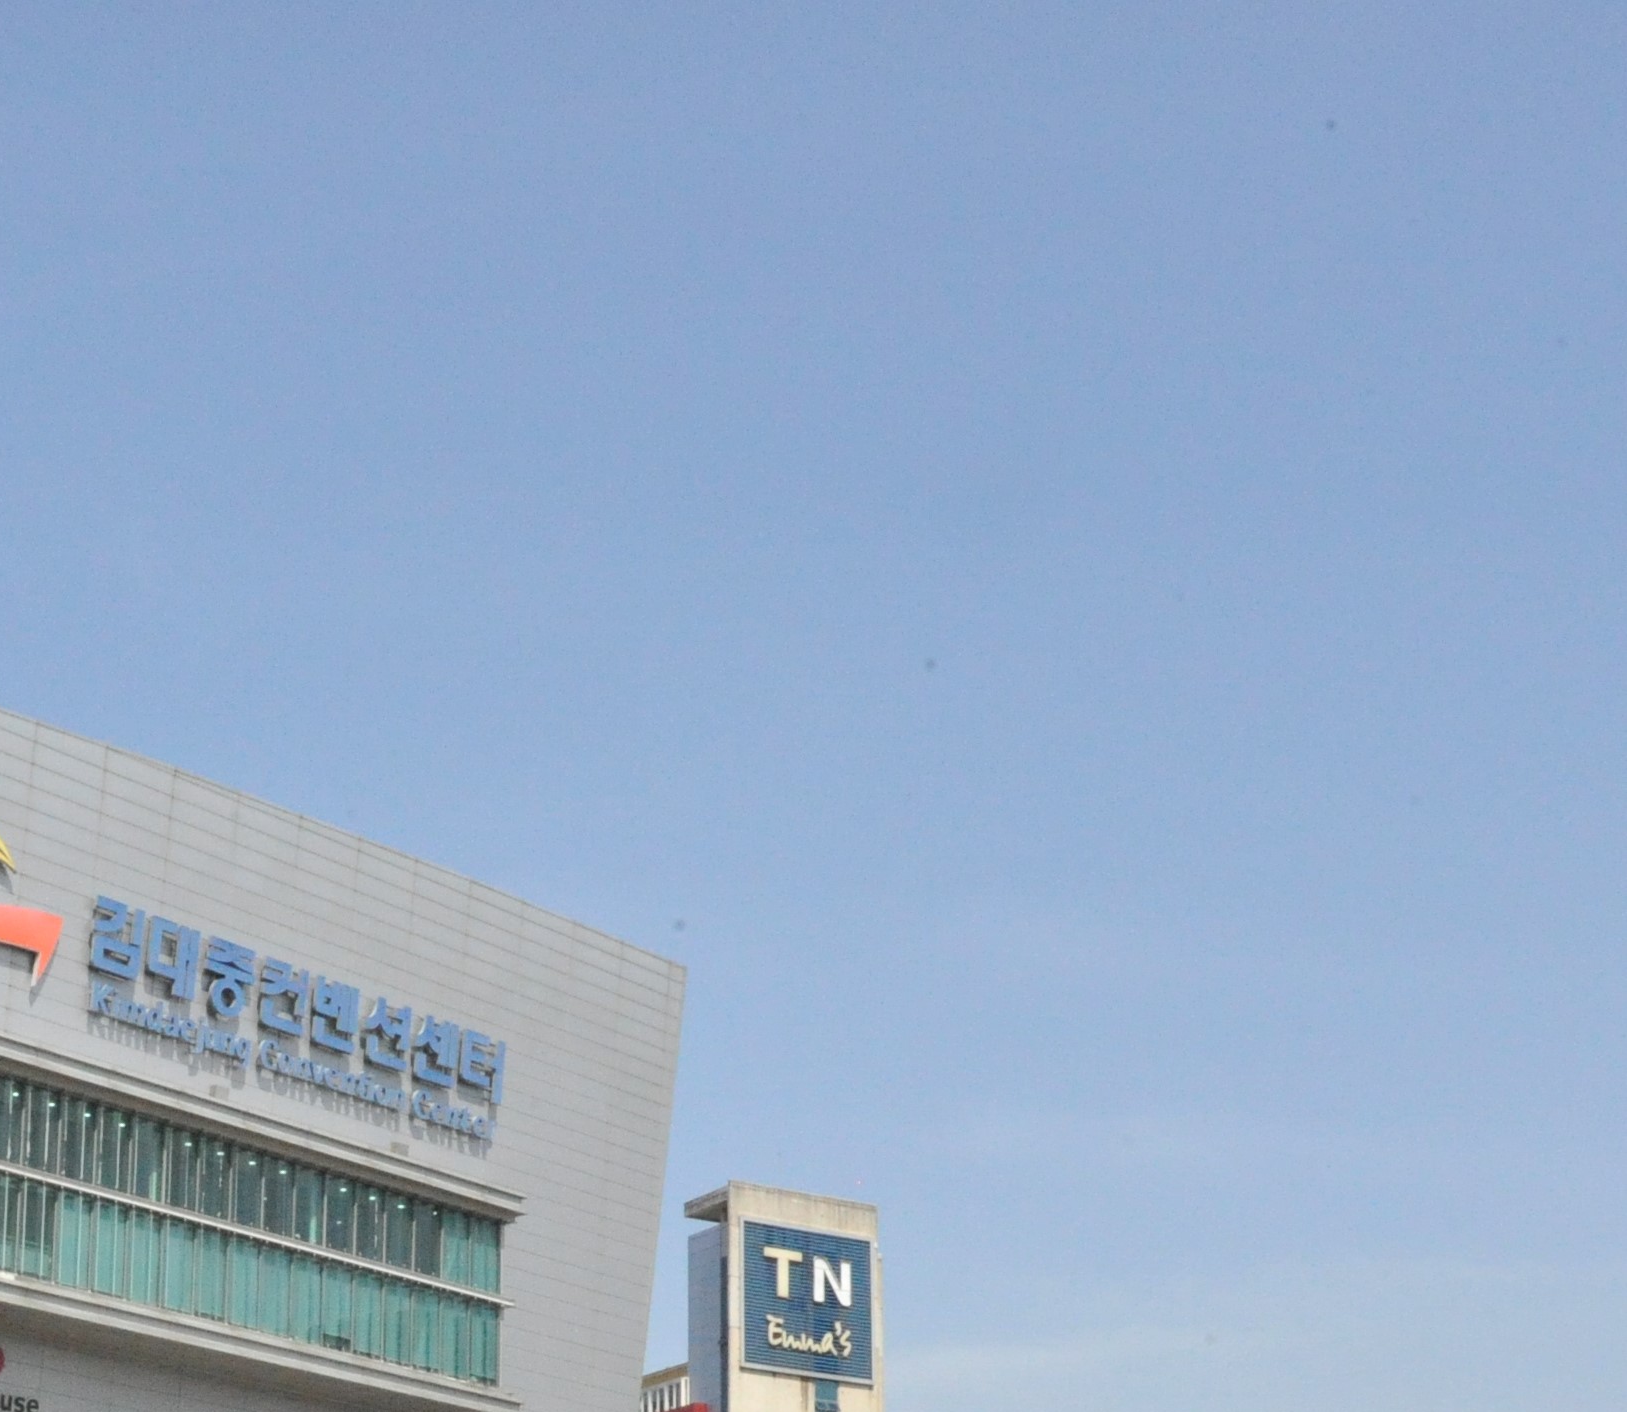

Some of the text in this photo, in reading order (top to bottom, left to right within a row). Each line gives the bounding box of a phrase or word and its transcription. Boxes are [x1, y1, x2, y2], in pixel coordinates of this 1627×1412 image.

[89, 895, 506, 1105] 김대중컨벤션센터
[90, 980, 497, 1141] Kimdaejung Convention Center
[763, 1246, 852, 1307] TN
[766, 1314, 852, 1357] Emma's
